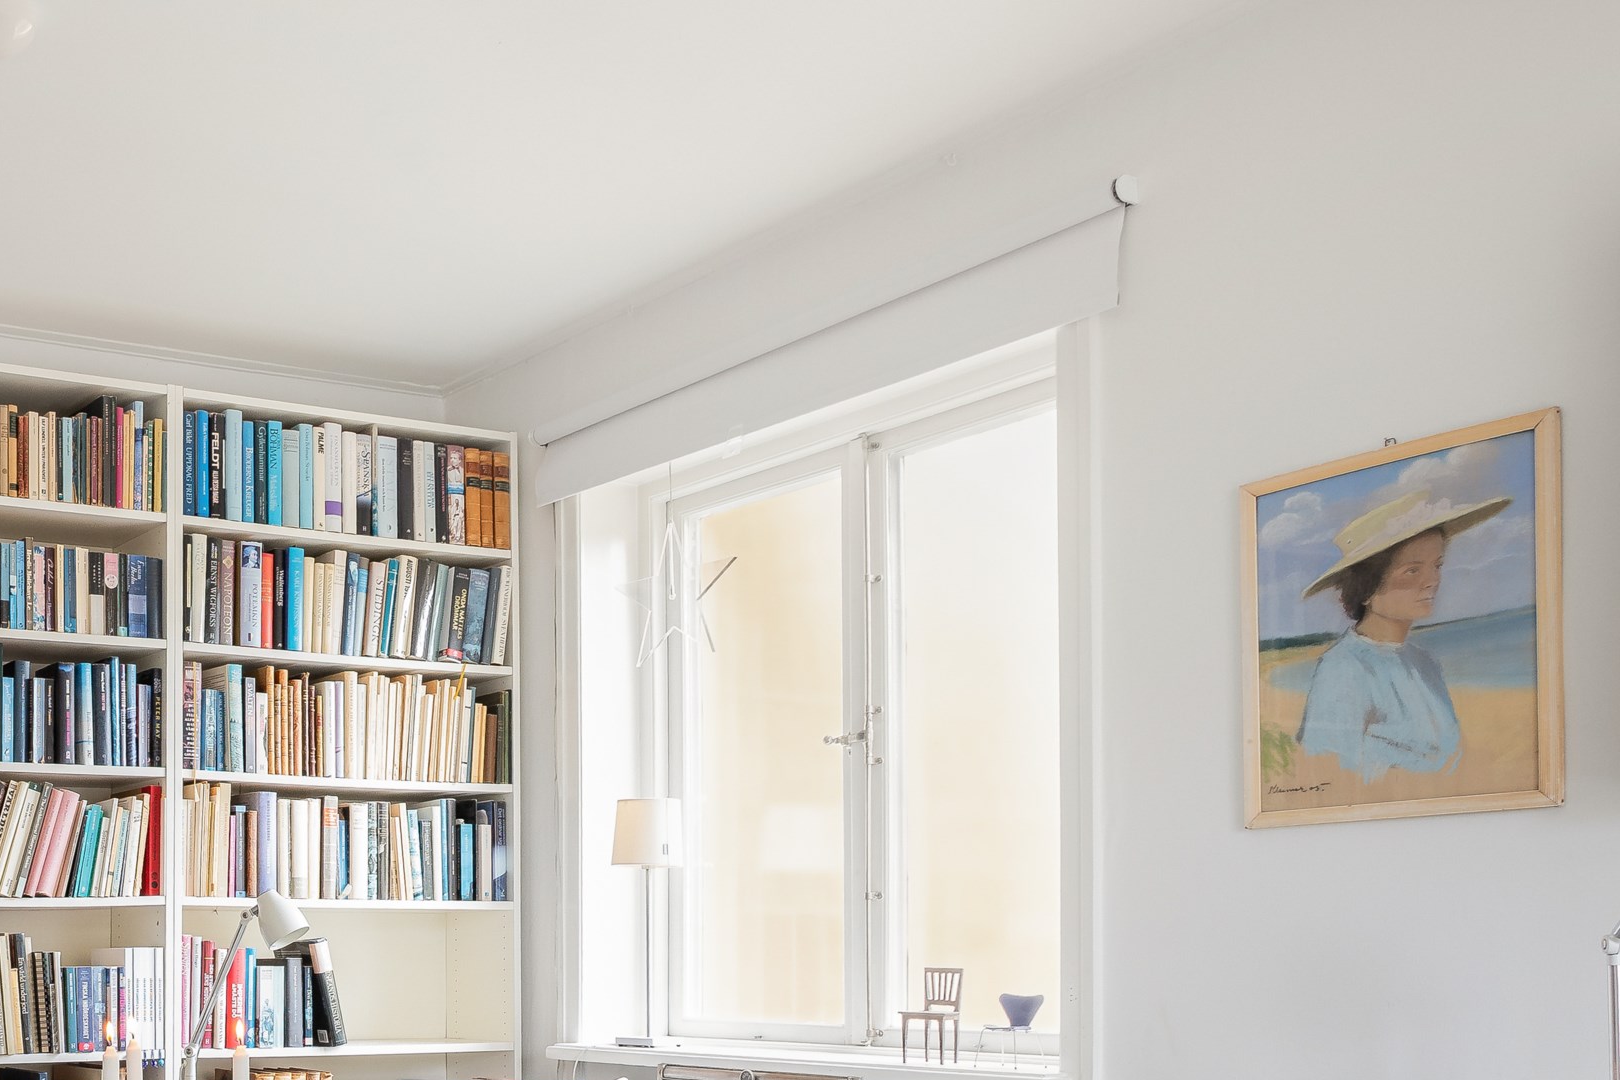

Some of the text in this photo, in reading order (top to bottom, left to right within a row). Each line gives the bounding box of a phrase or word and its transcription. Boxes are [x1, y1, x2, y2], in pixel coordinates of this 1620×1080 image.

[257, 426, 266, 482] Gyllenhammar
[269, 428, 279, 470] BOHMAN
[245, 447, 253, 517] BRÖDERNA KREUGER
[223, 572, 232, 634] NAPOLEON
[371, 579, 384, 642] STEDINGK
[452, 595, 461, 630] DRÖMMAR
[457, 610, 466, 639] NÄTTERS
[18, 957, 25, 966] En
[18, 966, 26, 982] värld
[20, 1001, 28, 1014] jord
